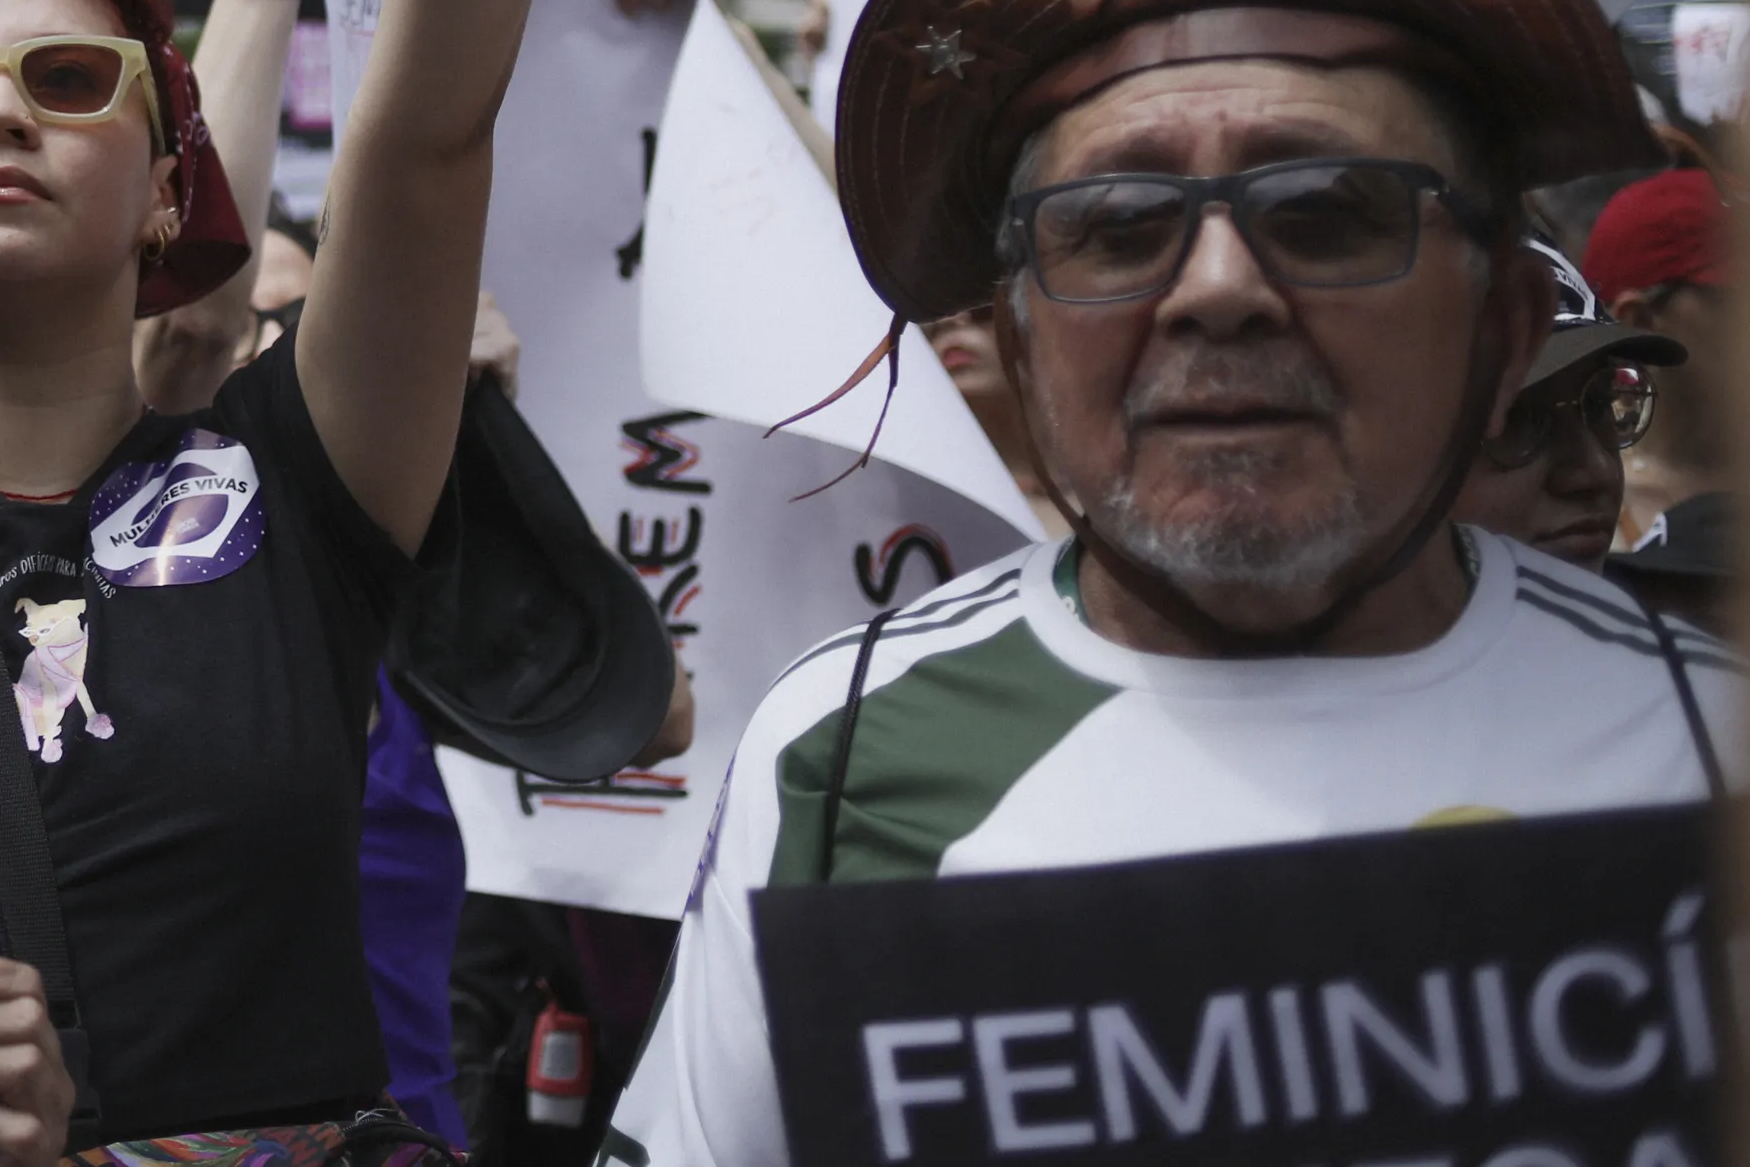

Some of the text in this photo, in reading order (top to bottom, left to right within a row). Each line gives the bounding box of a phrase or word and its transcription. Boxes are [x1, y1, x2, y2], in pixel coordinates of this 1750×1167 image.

[110, 482, 191, 548] MULHERES
[193, 476, 249, 495] VIVAS
[55, 556, 77, 578] PARA
[861, 892, 1717, 1162] FEMINICÍ
